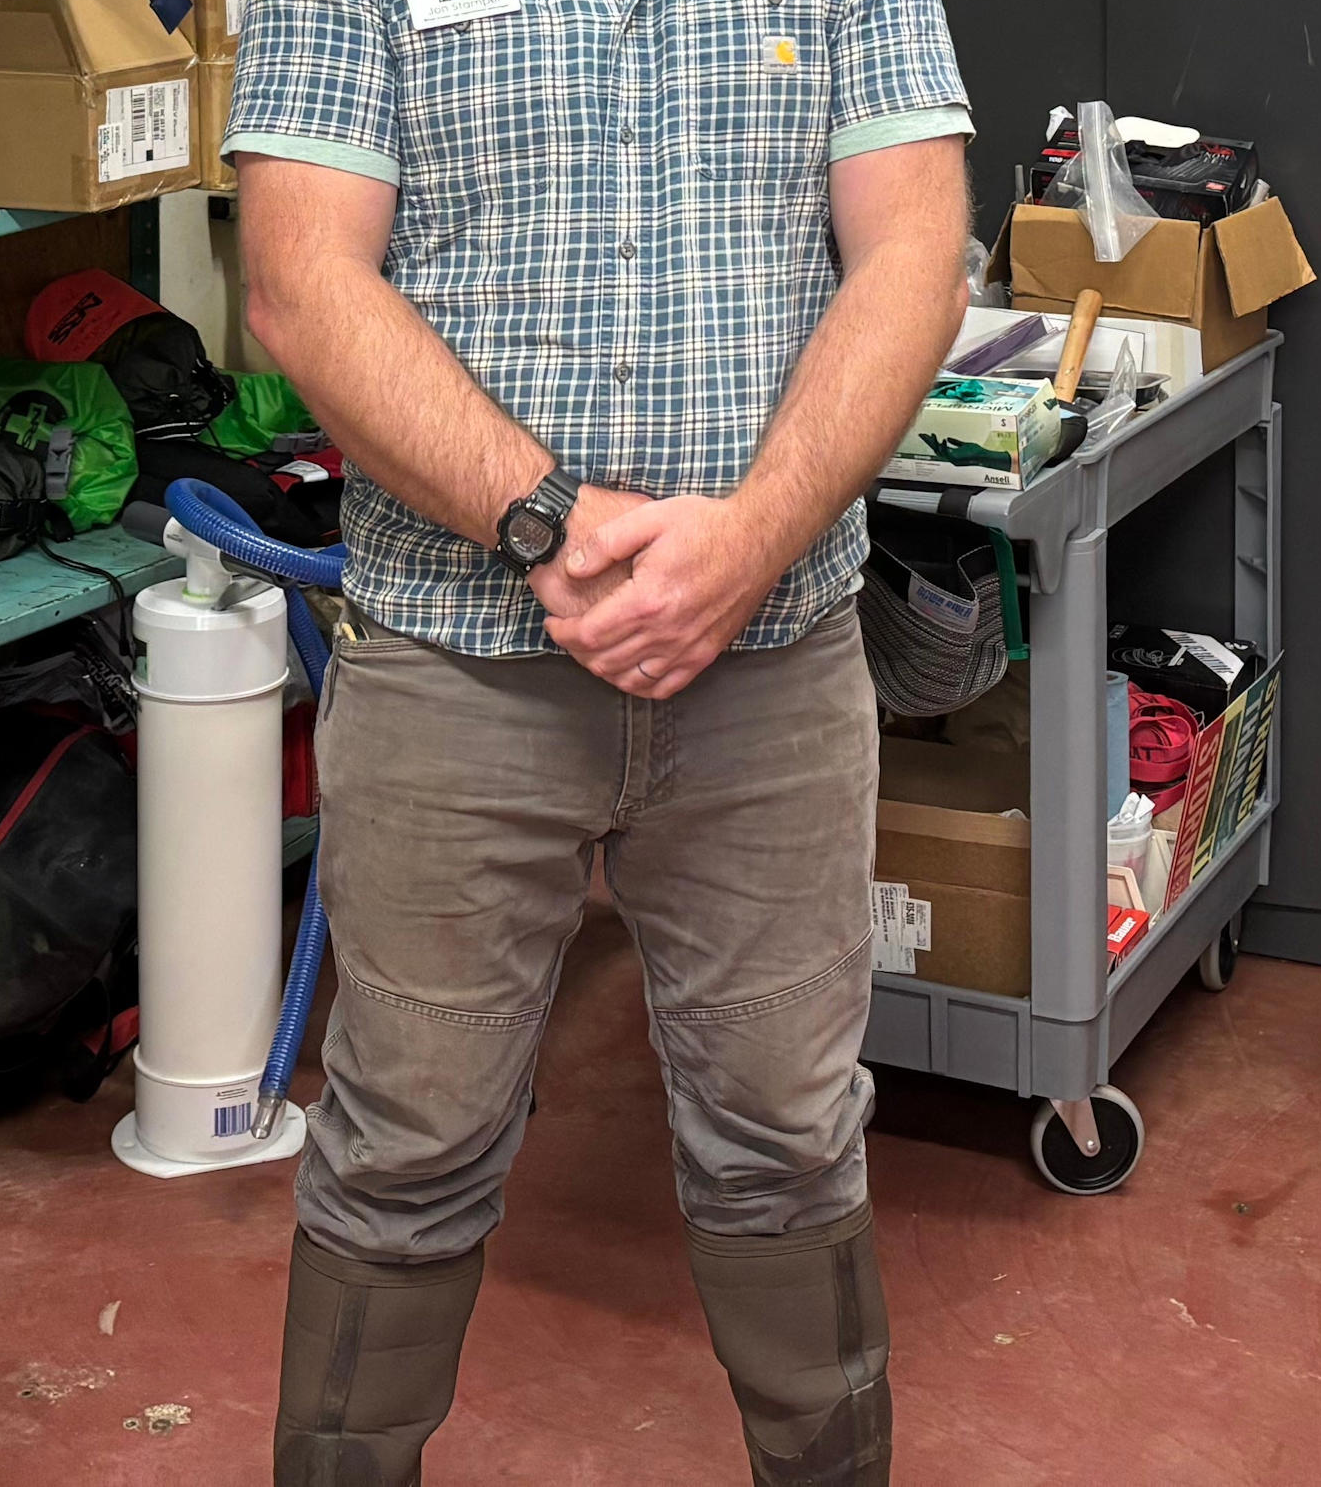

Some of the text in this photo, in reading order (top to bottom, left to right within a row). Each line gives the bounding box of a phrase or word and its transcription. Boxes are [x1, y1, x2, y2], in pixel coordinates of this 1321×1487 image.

[429, 7, 449, 16] Jon
[983, 474, 1011, 485] Ansell
[1106, 916, 1137, 944] Bauer
